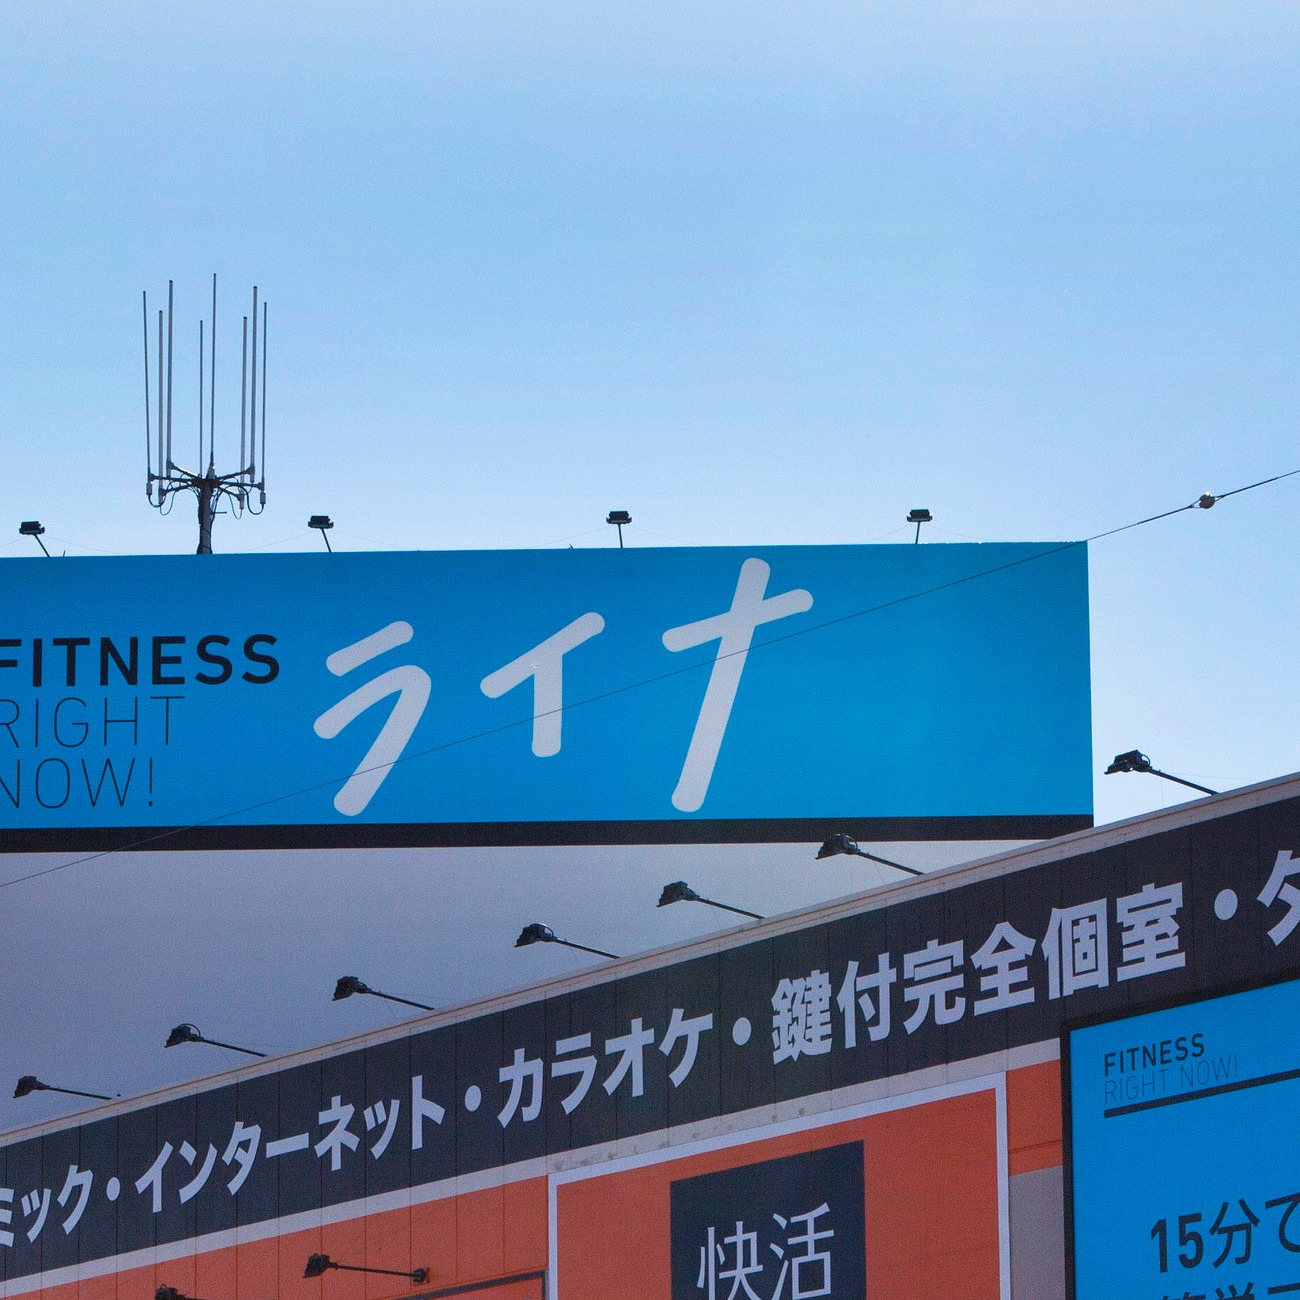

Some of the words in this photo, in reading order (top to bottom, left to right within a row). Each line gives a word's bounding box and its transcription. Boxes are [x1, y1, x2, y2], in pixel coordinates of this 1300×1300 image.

[1104, 1033, 1205, 1077] FITNESS
[1104, 1068, 1172, 1105] RIGHT
[1180, 1053, 1239, 1089] NOW!
